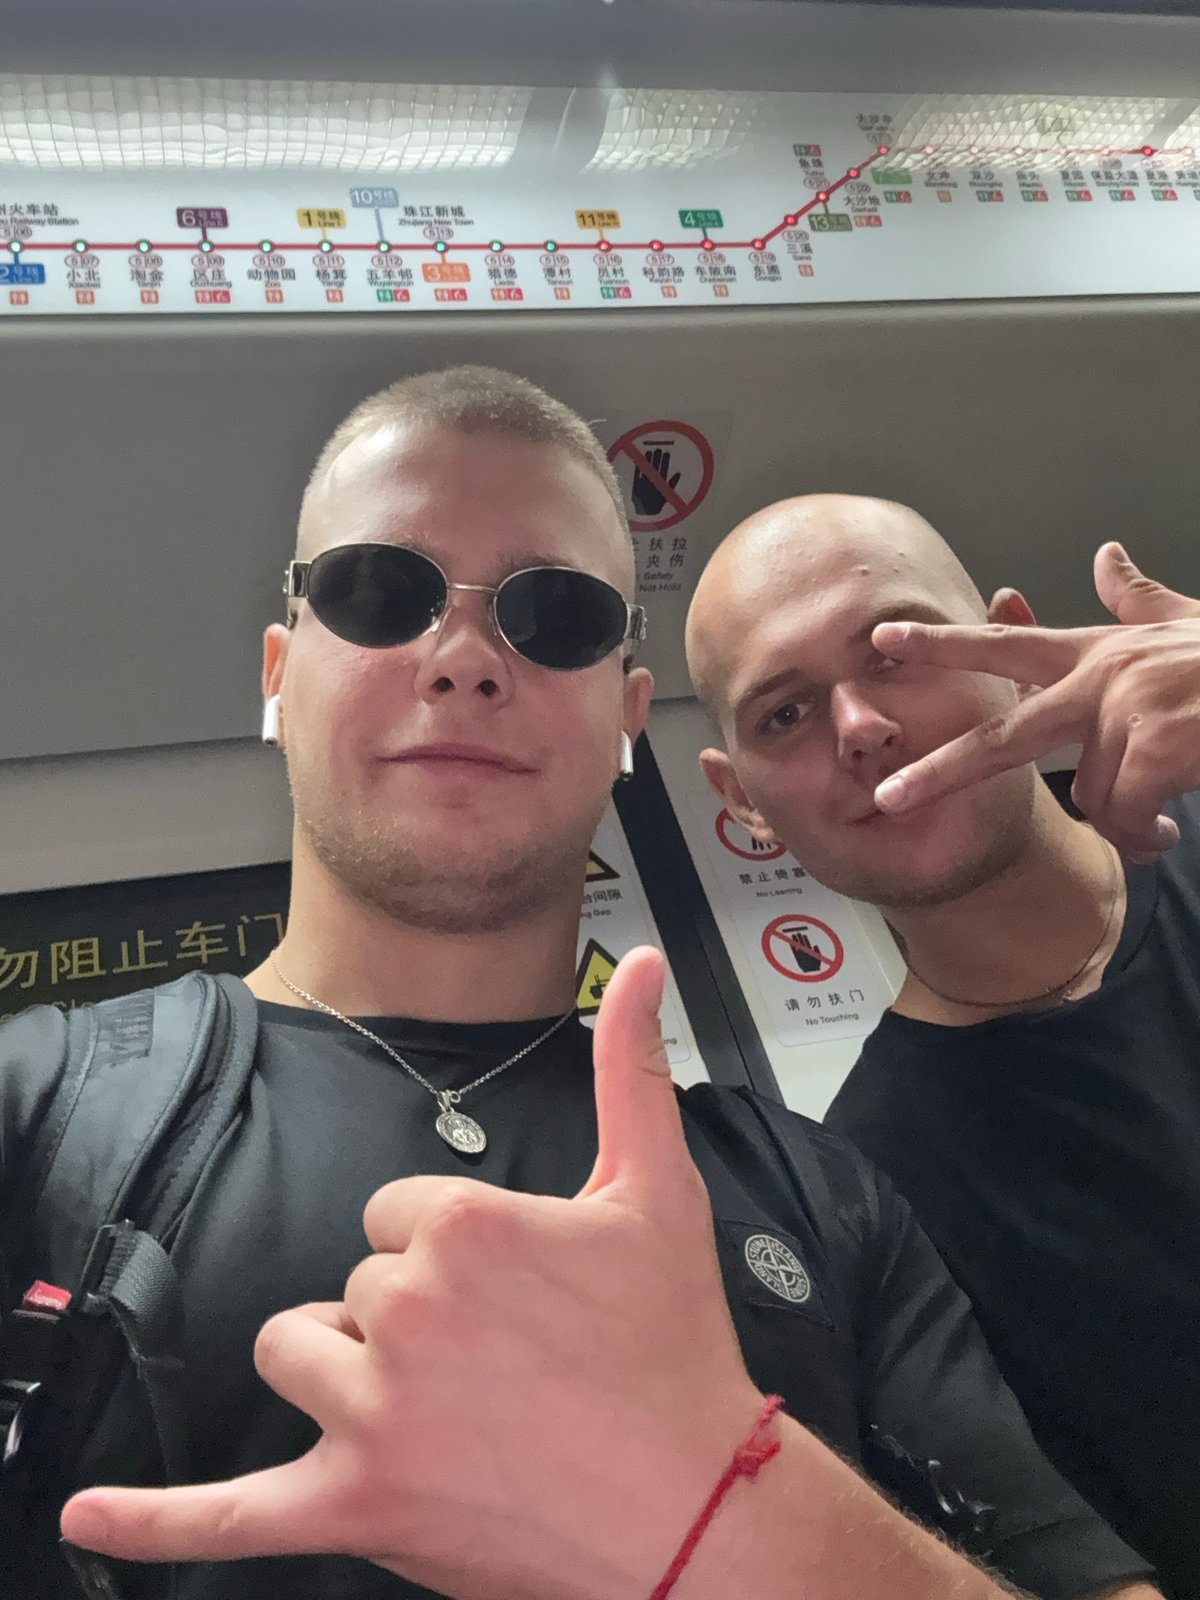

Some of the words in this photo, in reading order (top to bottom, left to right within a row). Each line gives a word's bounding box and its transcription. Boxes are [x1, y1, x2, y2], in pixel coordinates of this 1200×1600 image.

[352, 190, 372, 205] 10
[403, 205, 466, 217] 珠江新城
[11, 217, 46, 226] Railway
[48, 217, 79, 226] Station
[182, 210, 196, 227] 6
[303, 210, 312, 227] 1
[398, 218, 432, 227] Zhujiang
[578, 213, 596, 227] 11
[684, 212, 697, 226] 4
[811, 216, 829, 231] 13
[67, 270, 100, 281] 小北
[193, 269, 226, 281] 区庄
[247, 269, 296, 280] 动物园
[427, 265, 440, 281] 3
[642, 267, 684, 278] 科韵路
[643, 571, 673, 580] Safety
[639, 584, 656, 592] Not
[660, 582, 681, 591] Hold
[739, 866, 806, 884] 禁止倚靠
[769, 887, 803, 897] Leaning
[0, 913, 285, 989] 勿阻止车门
[785, 989, 864, 1012] 请勿扶门
[805, 1018, 819, 1026] No
[819, 1012, 859, 1024] Touching
